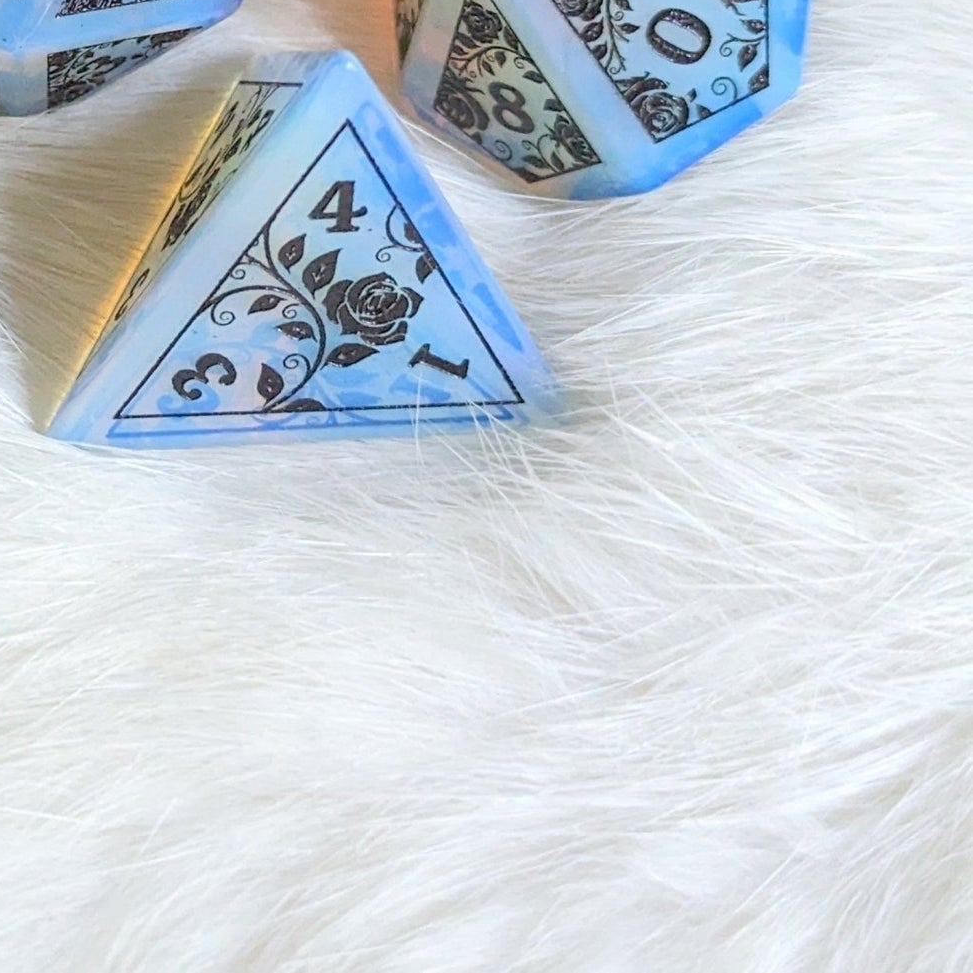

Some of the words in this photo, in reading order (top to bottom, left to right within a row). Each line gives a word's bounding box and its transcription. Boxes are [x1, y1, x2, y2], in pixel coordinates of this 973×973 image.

[646, 7, 712, 64] 0
[487, 79, 535, 134] 8
[308, 180, 368, 233] 4
[171, 352, 238, 402] 3
[407, 342, 470, 379] 1
